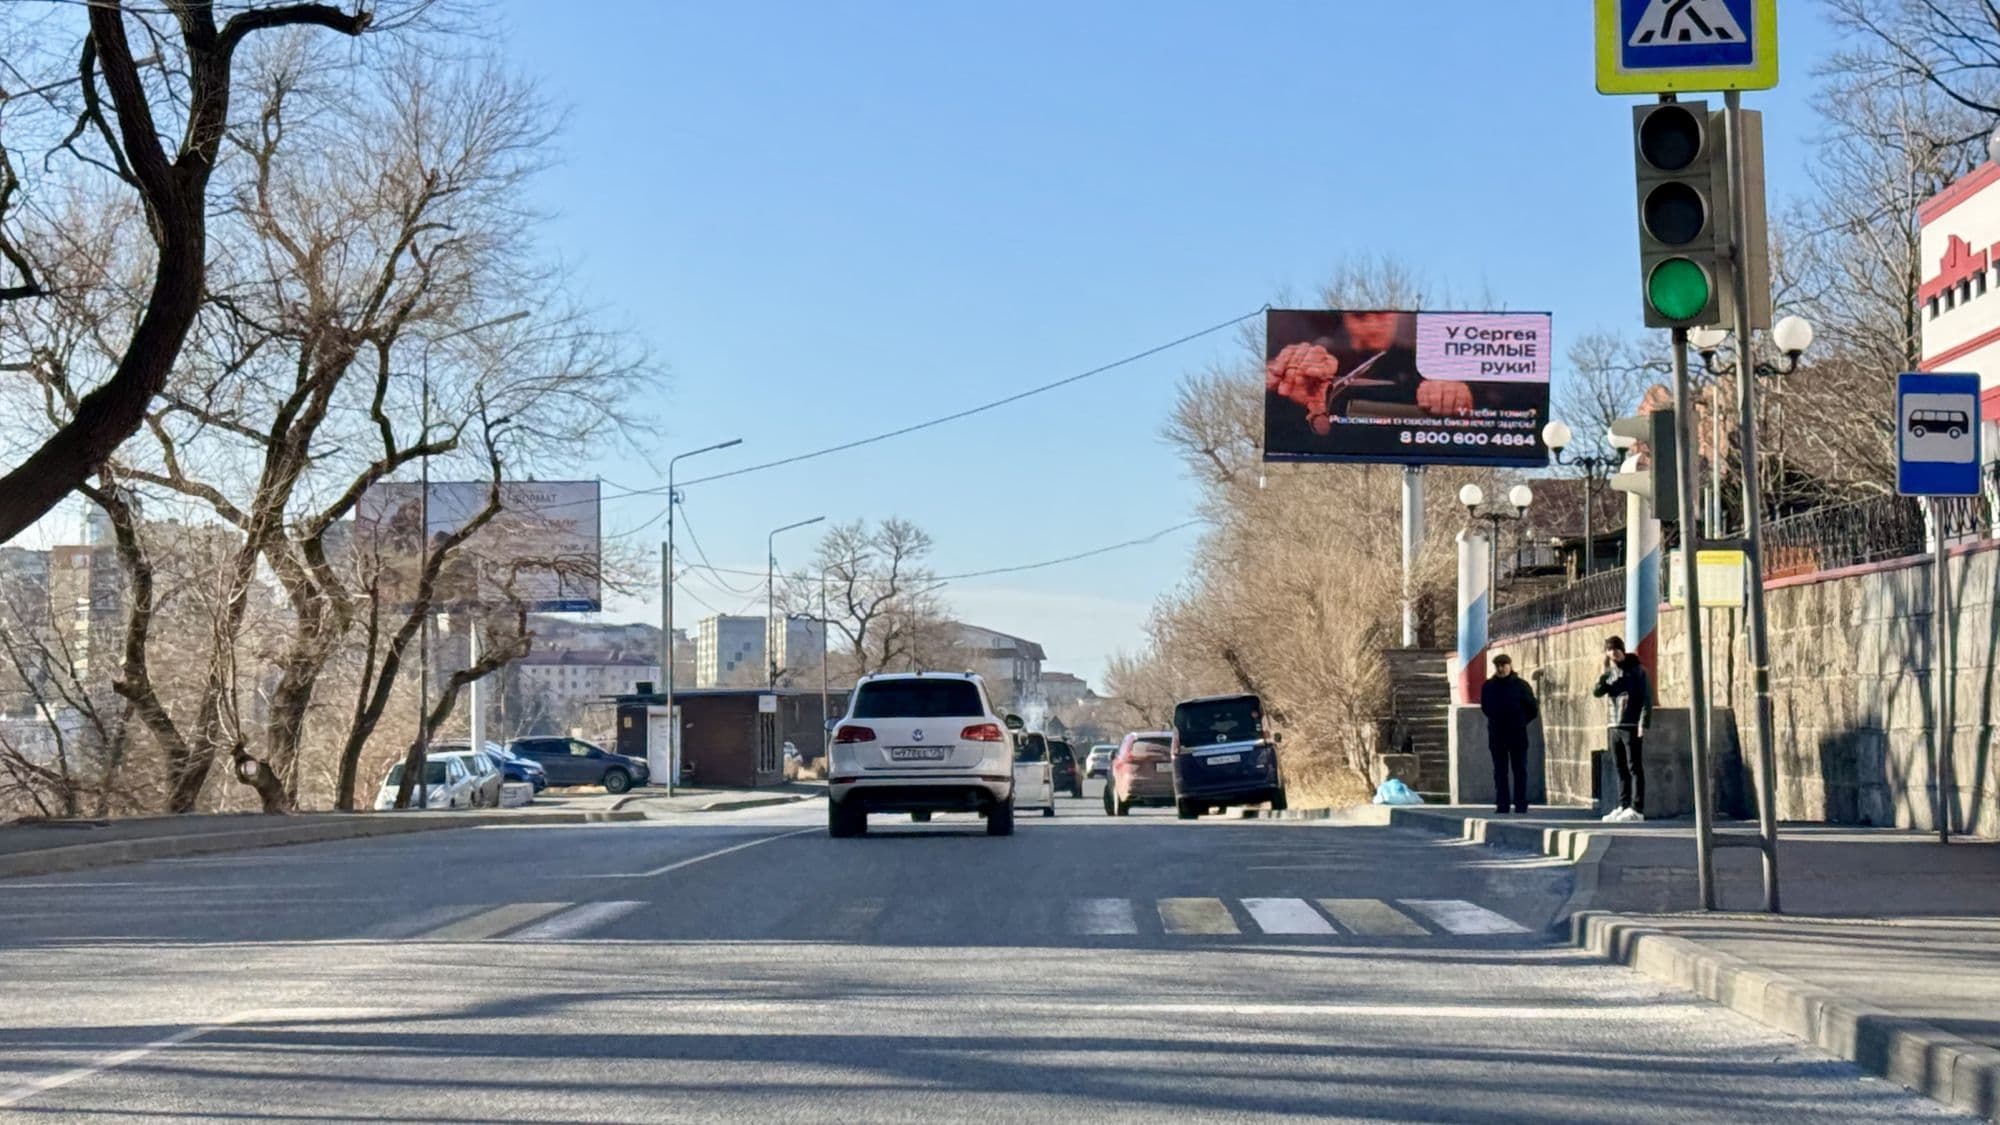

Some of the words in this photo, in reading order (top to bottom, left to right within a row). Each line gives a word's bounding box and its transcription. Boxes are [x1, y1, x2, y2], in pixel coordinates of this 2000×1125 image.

[1446, 326, 1460, 339] У
[1464, 326, 1536, 342] Сергея
[1444, 342, 1537, 357] ПРЯМЫЕ
[1480, 360, 1537, 375] руки!
[1399, 430, 1412, 444] 8
[1414, 430, 1450, 445] 800
[1452, 431, 1489, 445] 600
